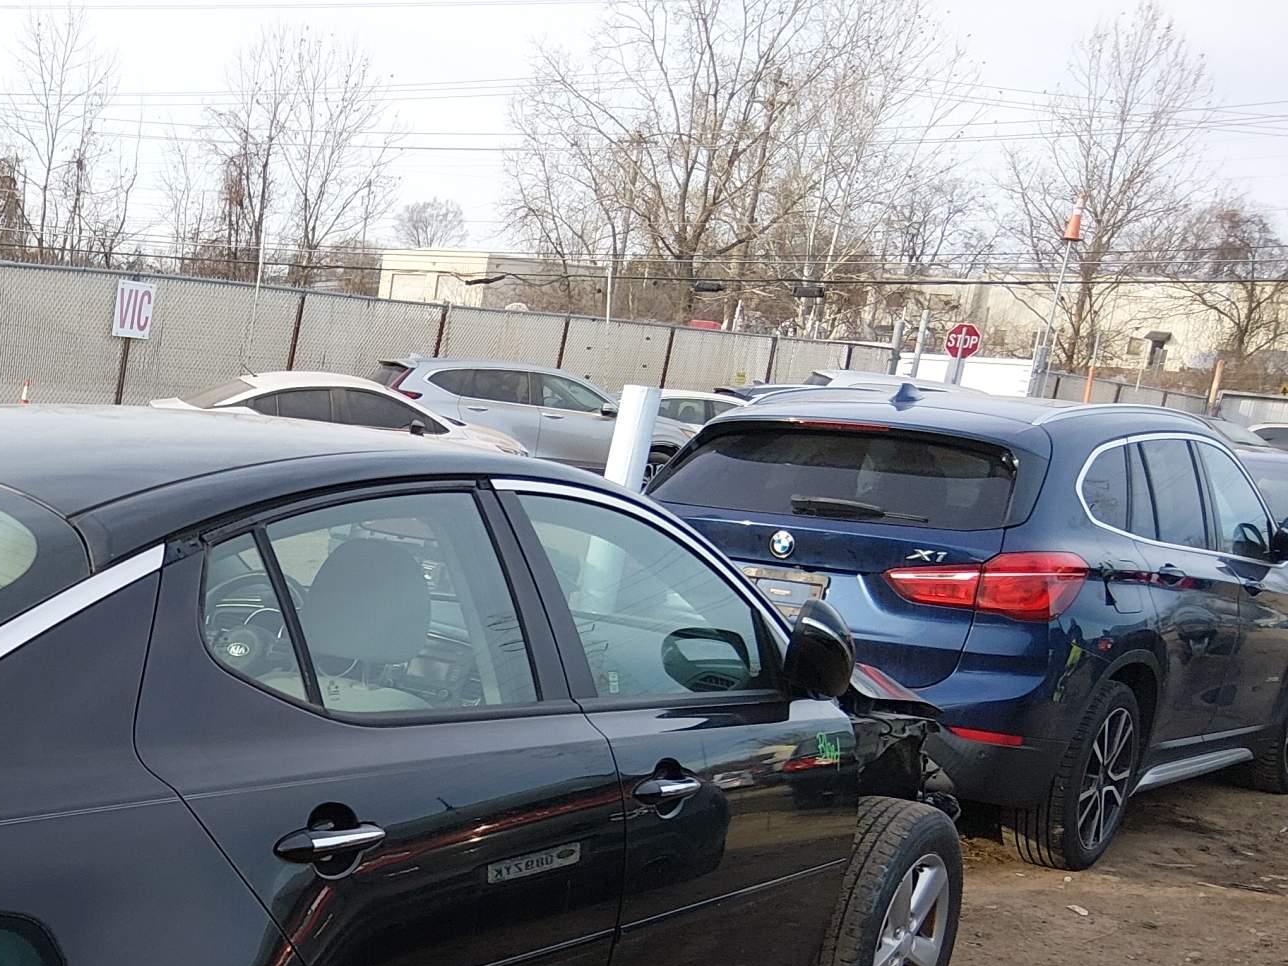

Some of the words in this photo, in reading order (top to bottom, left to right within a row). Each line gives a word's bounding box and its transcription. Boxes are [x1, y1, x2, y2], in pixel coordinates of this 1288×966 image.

[119, 287, 152, 332] VIC
[905, 549, 948, 563] X1
[229, 645, 247, 656] KIA
